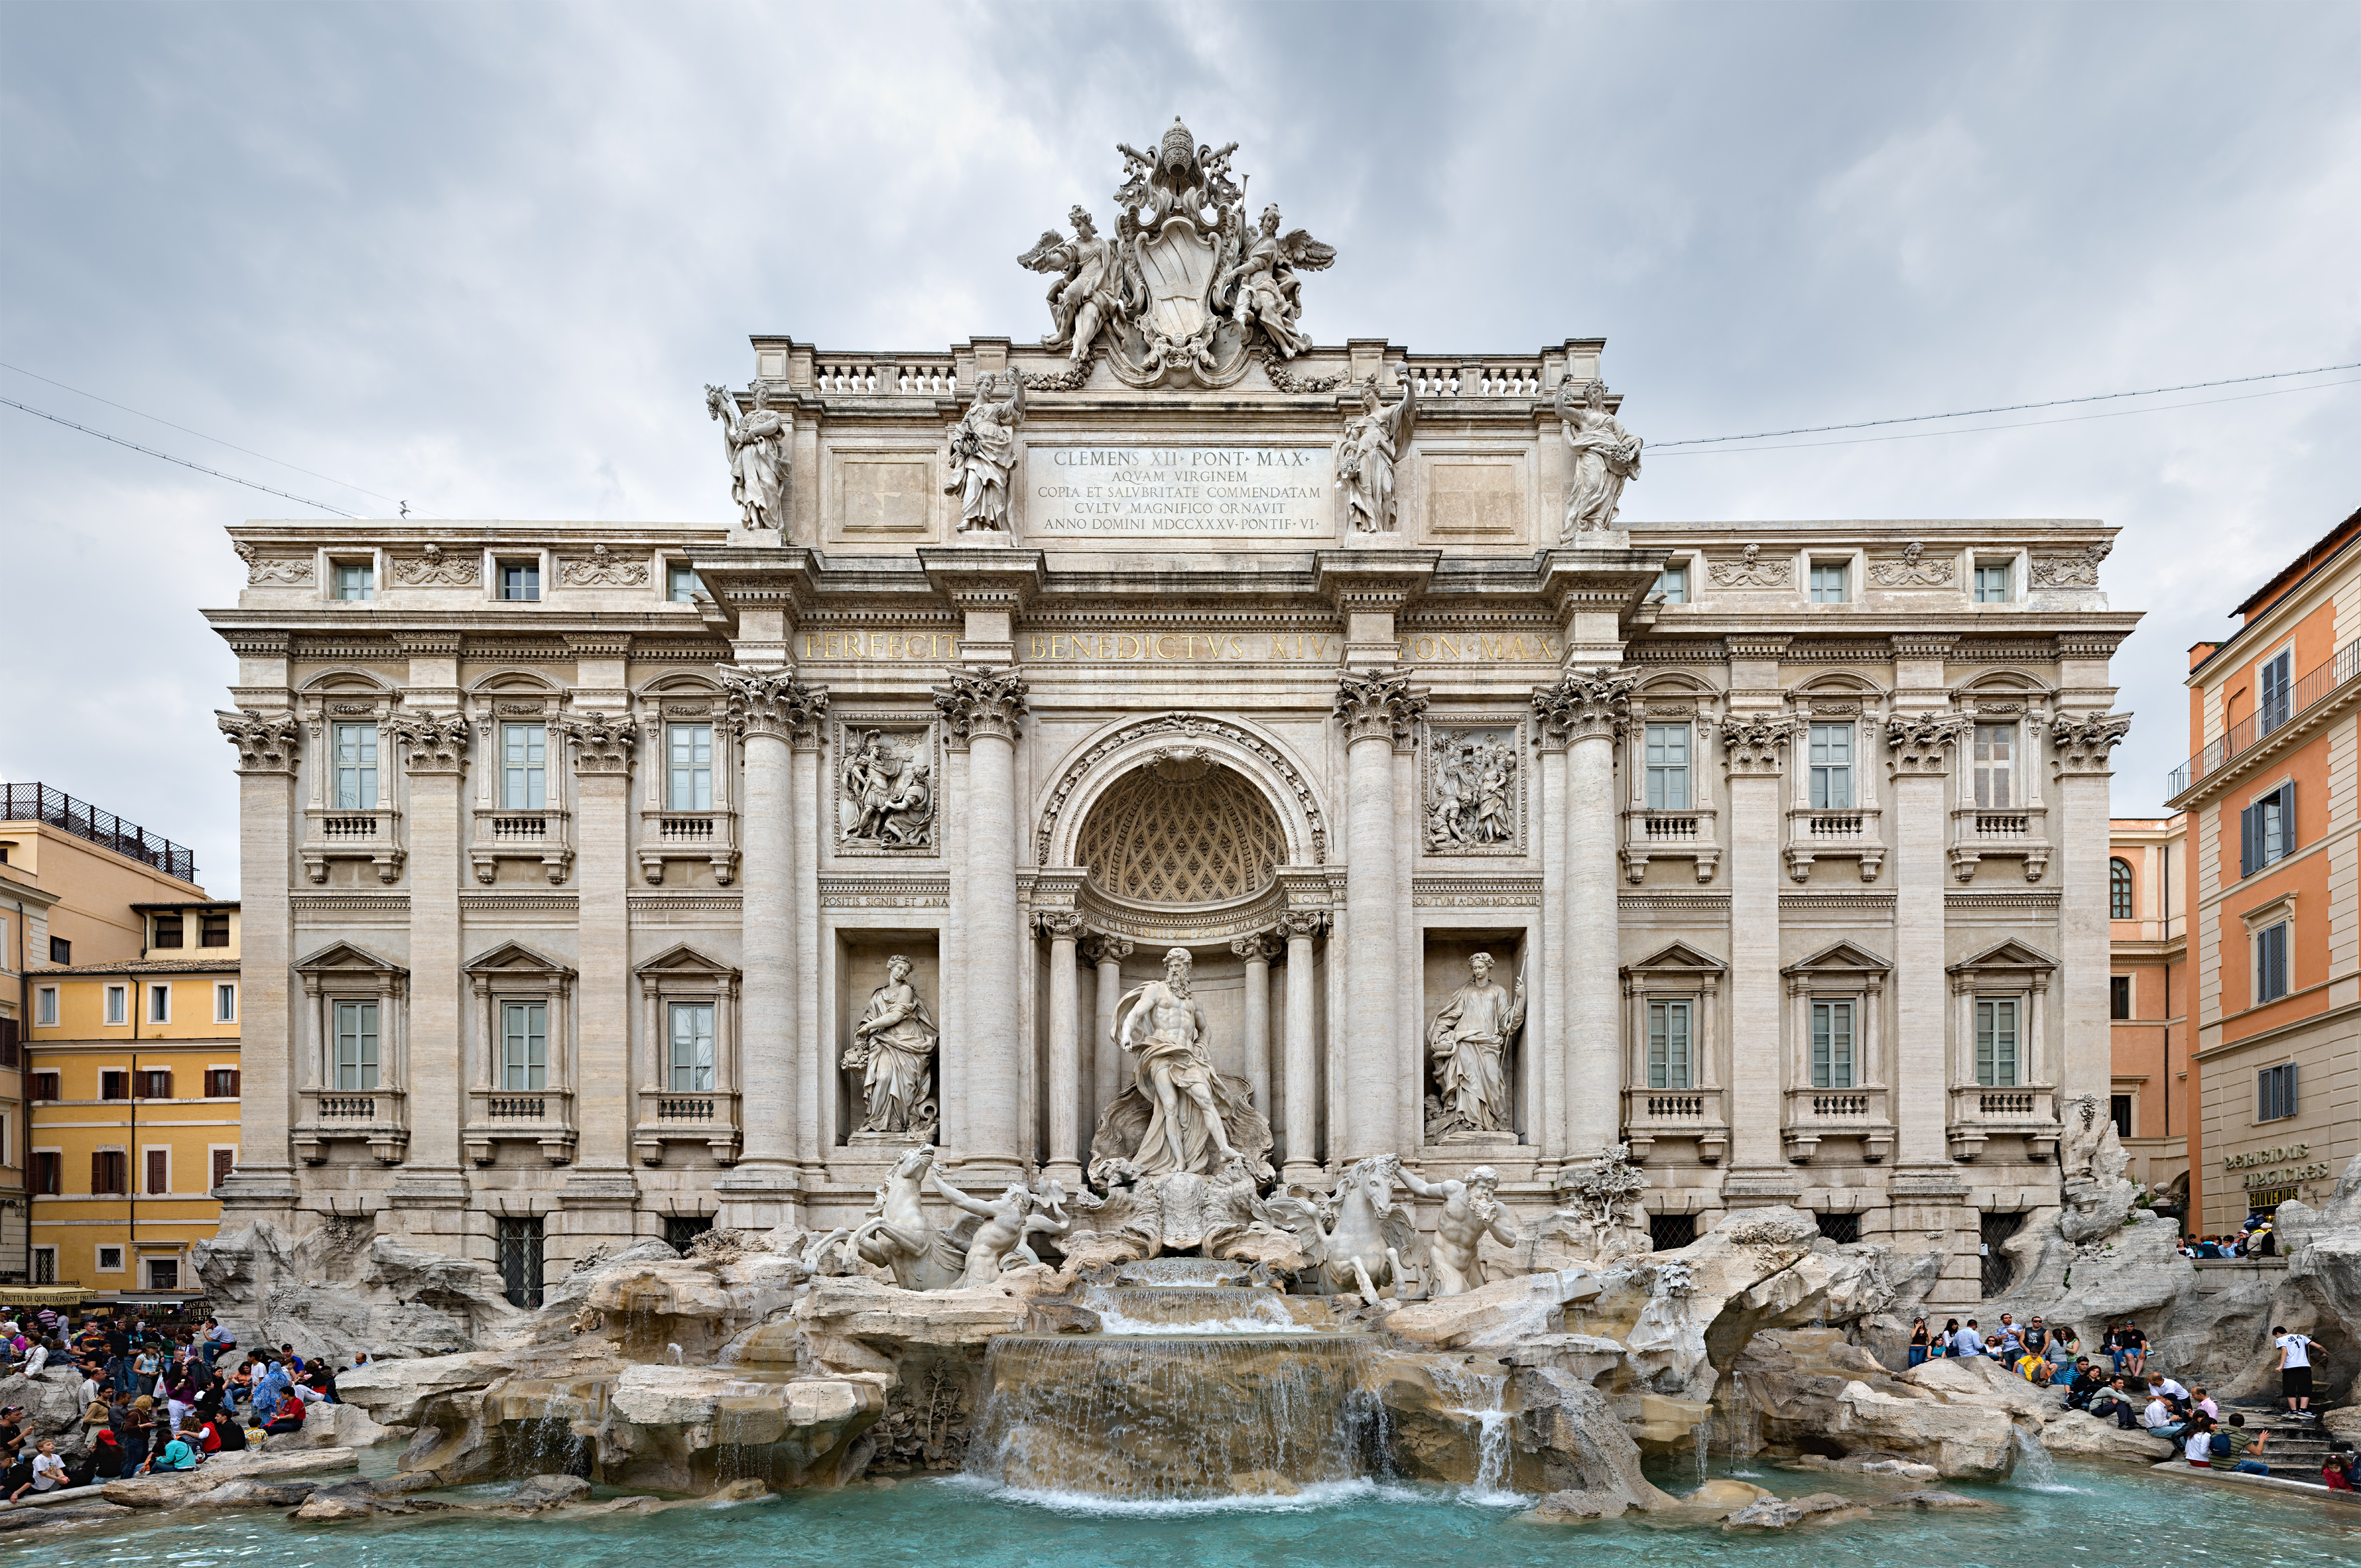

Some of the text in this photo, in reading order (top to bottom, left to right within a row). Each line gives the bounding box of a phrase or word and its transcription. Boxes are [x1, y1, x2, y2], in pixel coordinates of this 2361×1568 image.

[1054, 451, 1140, 467] CLEMENS
[1112, 471, 1248, 485] AQVAM VIRGINEM
[1038, 486, 1321, 498] COPIA ET SALVBRITATE COMMENDATAM
[1075, 502, 1286, 515] CVLTV MAGNIFICO ORNAVIT
[1044, 519, 1087, 530] ANNO
[1092, 519, 1145, 530] DOMINI
[805, 634, 961, 658] PERFECIT
[1030, 635, 1243, 659] BENEDICTVS
[824, 898, 948, 906] POSITIS SIGNIS ET ANA
[1334, 892, 1346, 900] AB
[1413, 897, 1455, 906] SOLVTVM
[1258, 913, 1273, 925] OPVS
[2250, 1188, 2298, 1207] SOUVENIRS
